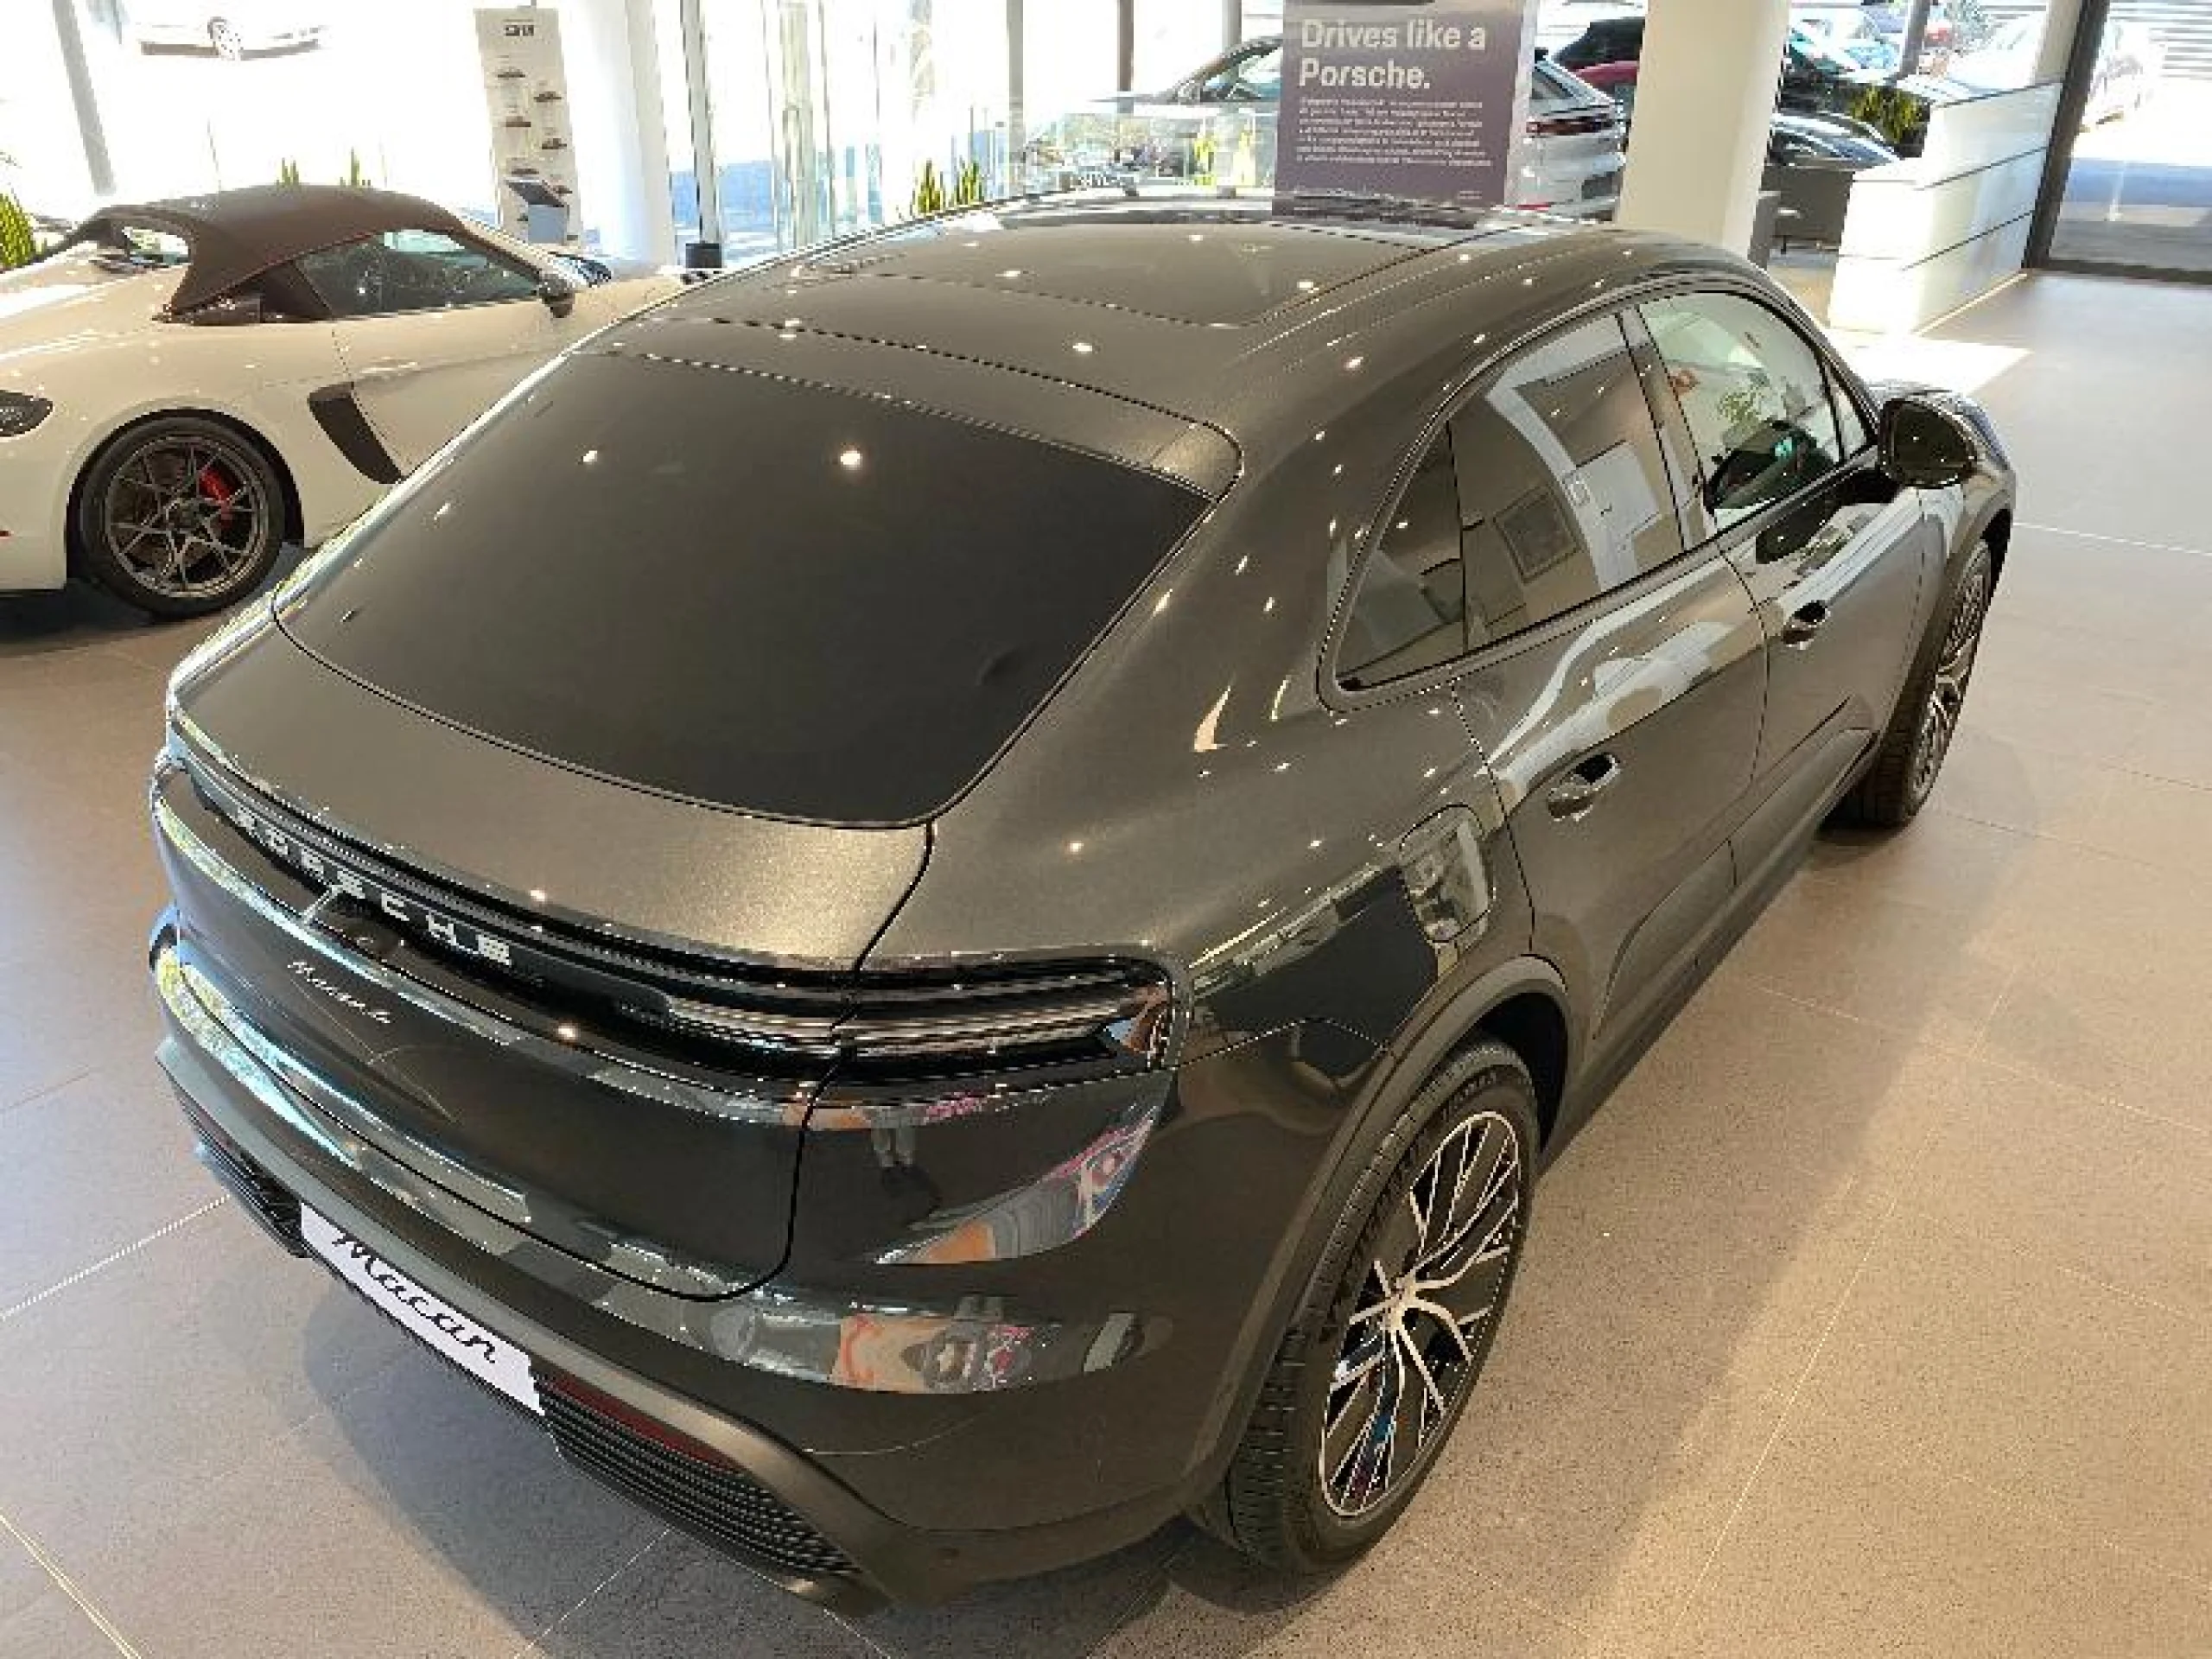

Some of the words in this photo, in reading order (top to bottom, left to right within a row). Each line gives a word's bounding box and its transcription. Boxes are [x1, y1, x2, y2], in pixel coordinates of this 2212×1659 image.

[1299, 57, 1430, 89] Porsche.
[1300, 19, 1397, 48] Drives
[1407, 18, 1461, 50] like
[1468, 27, 1485, 50] a
[236, 803, 512, 967] PORSCHE
[331, 1234, 496, 1363] Macan
